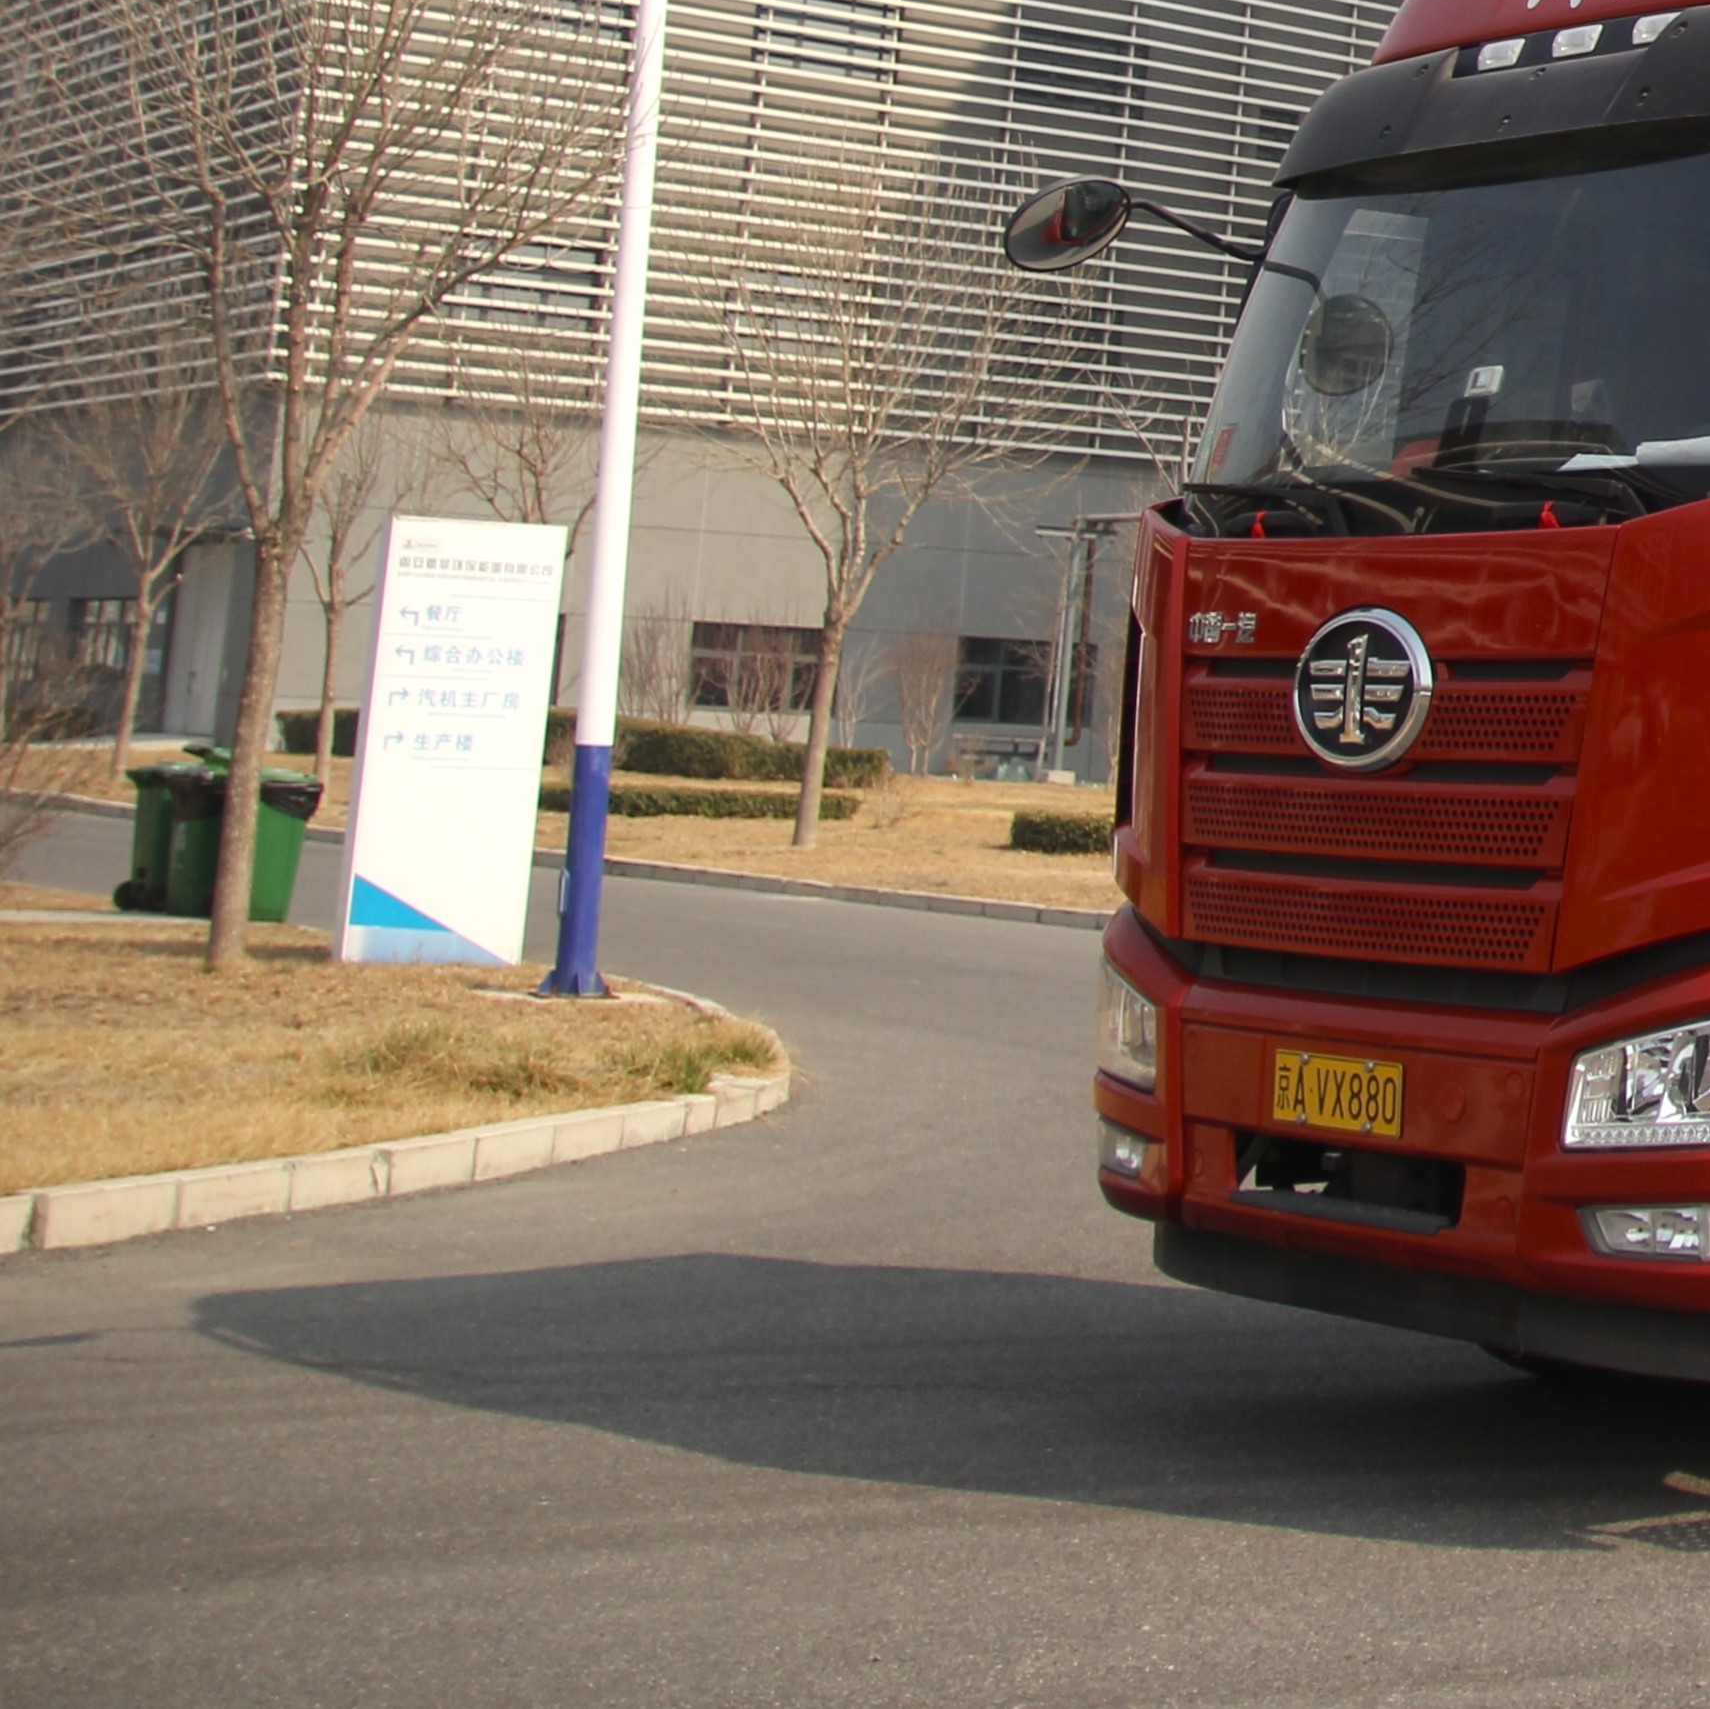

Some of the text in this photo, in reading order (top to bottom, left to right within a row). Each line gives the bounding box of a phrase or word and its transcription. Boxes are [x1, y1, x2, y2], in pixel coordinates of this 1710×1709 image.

[426, 605, 462, 622] 餐厅
[422, 645, 525, 667] 综合办公楼
[417, 688, 520, 711] 汽机主厂房
[412, 732, 474, 752] 生产楼
